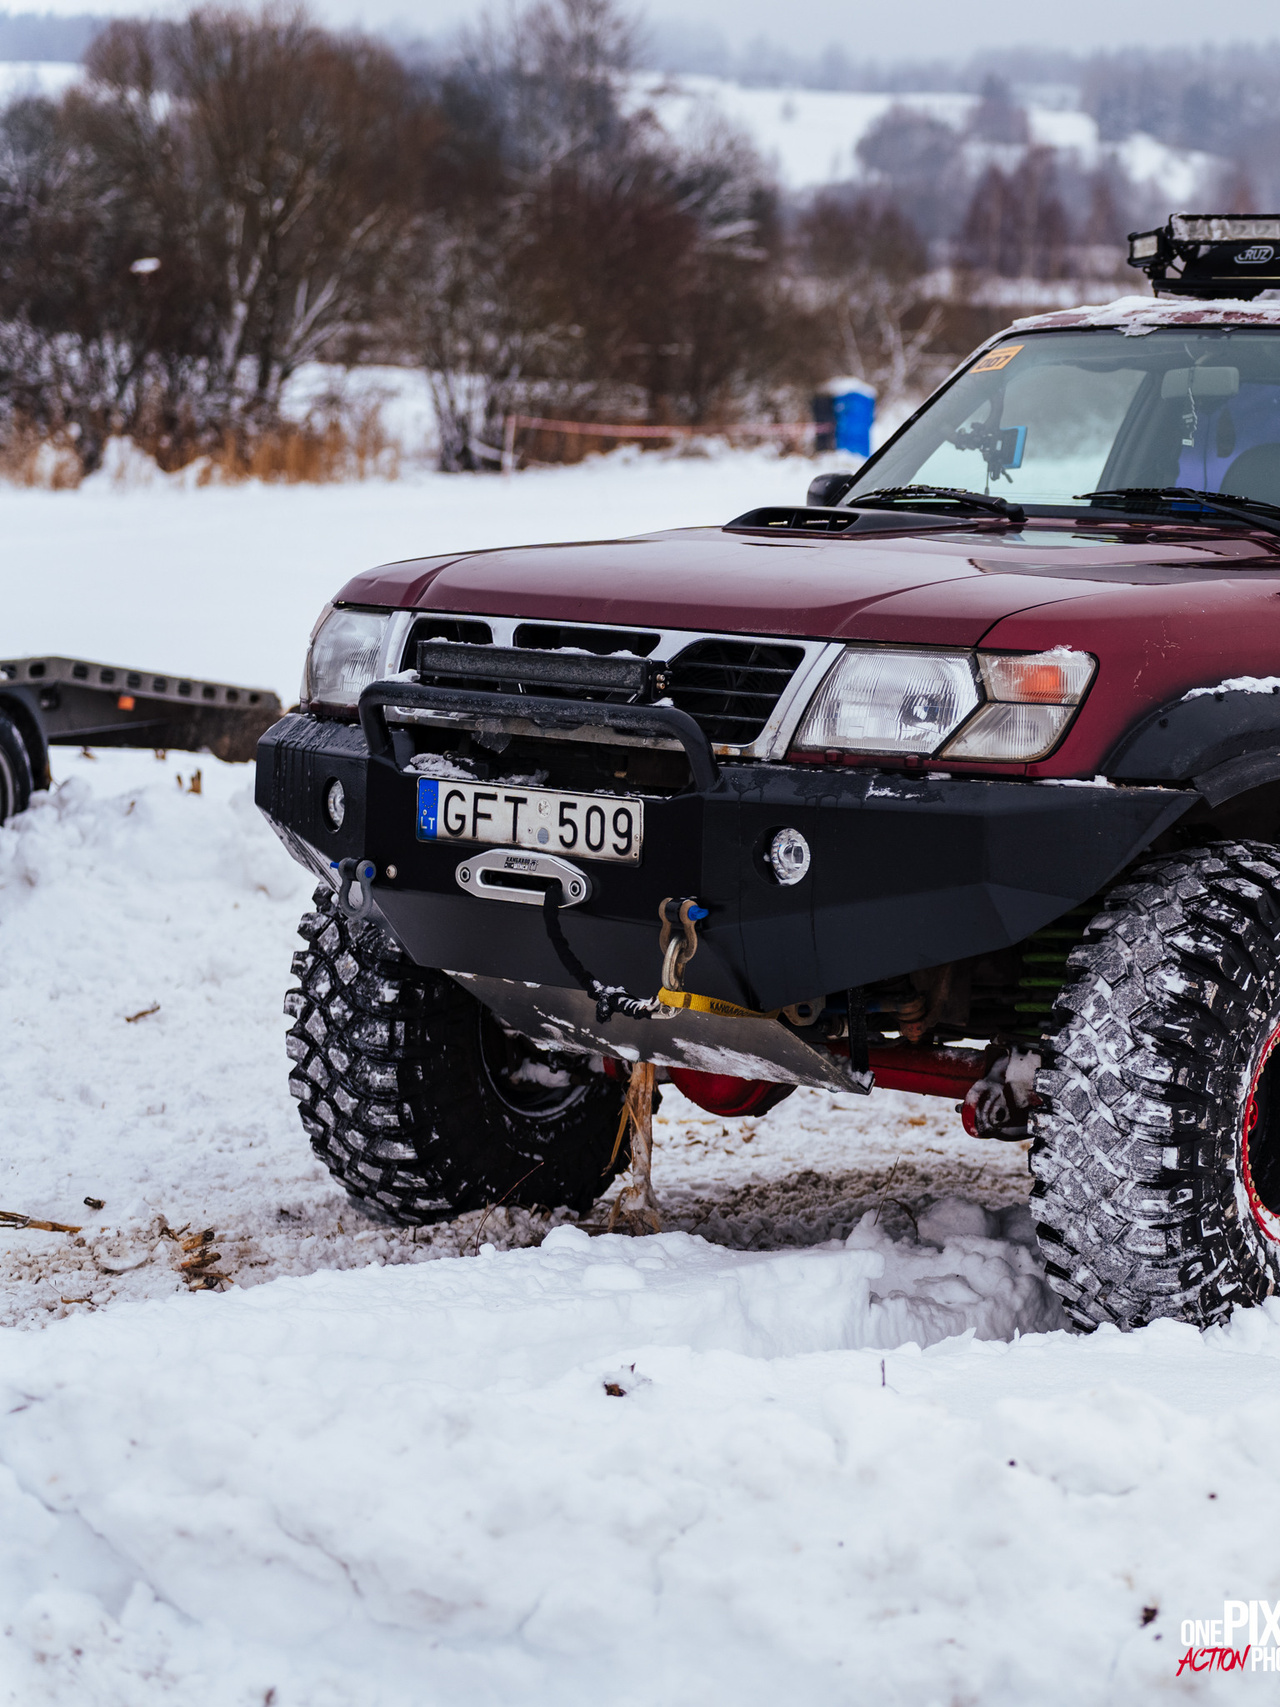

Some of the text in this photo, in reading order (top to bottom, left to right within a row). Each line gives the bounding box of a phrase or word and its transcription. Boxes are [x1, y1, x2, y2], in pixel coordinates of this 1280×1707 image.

[420, 815, 435, 831] LT
[443, 789, 633, 856] GFT 509
